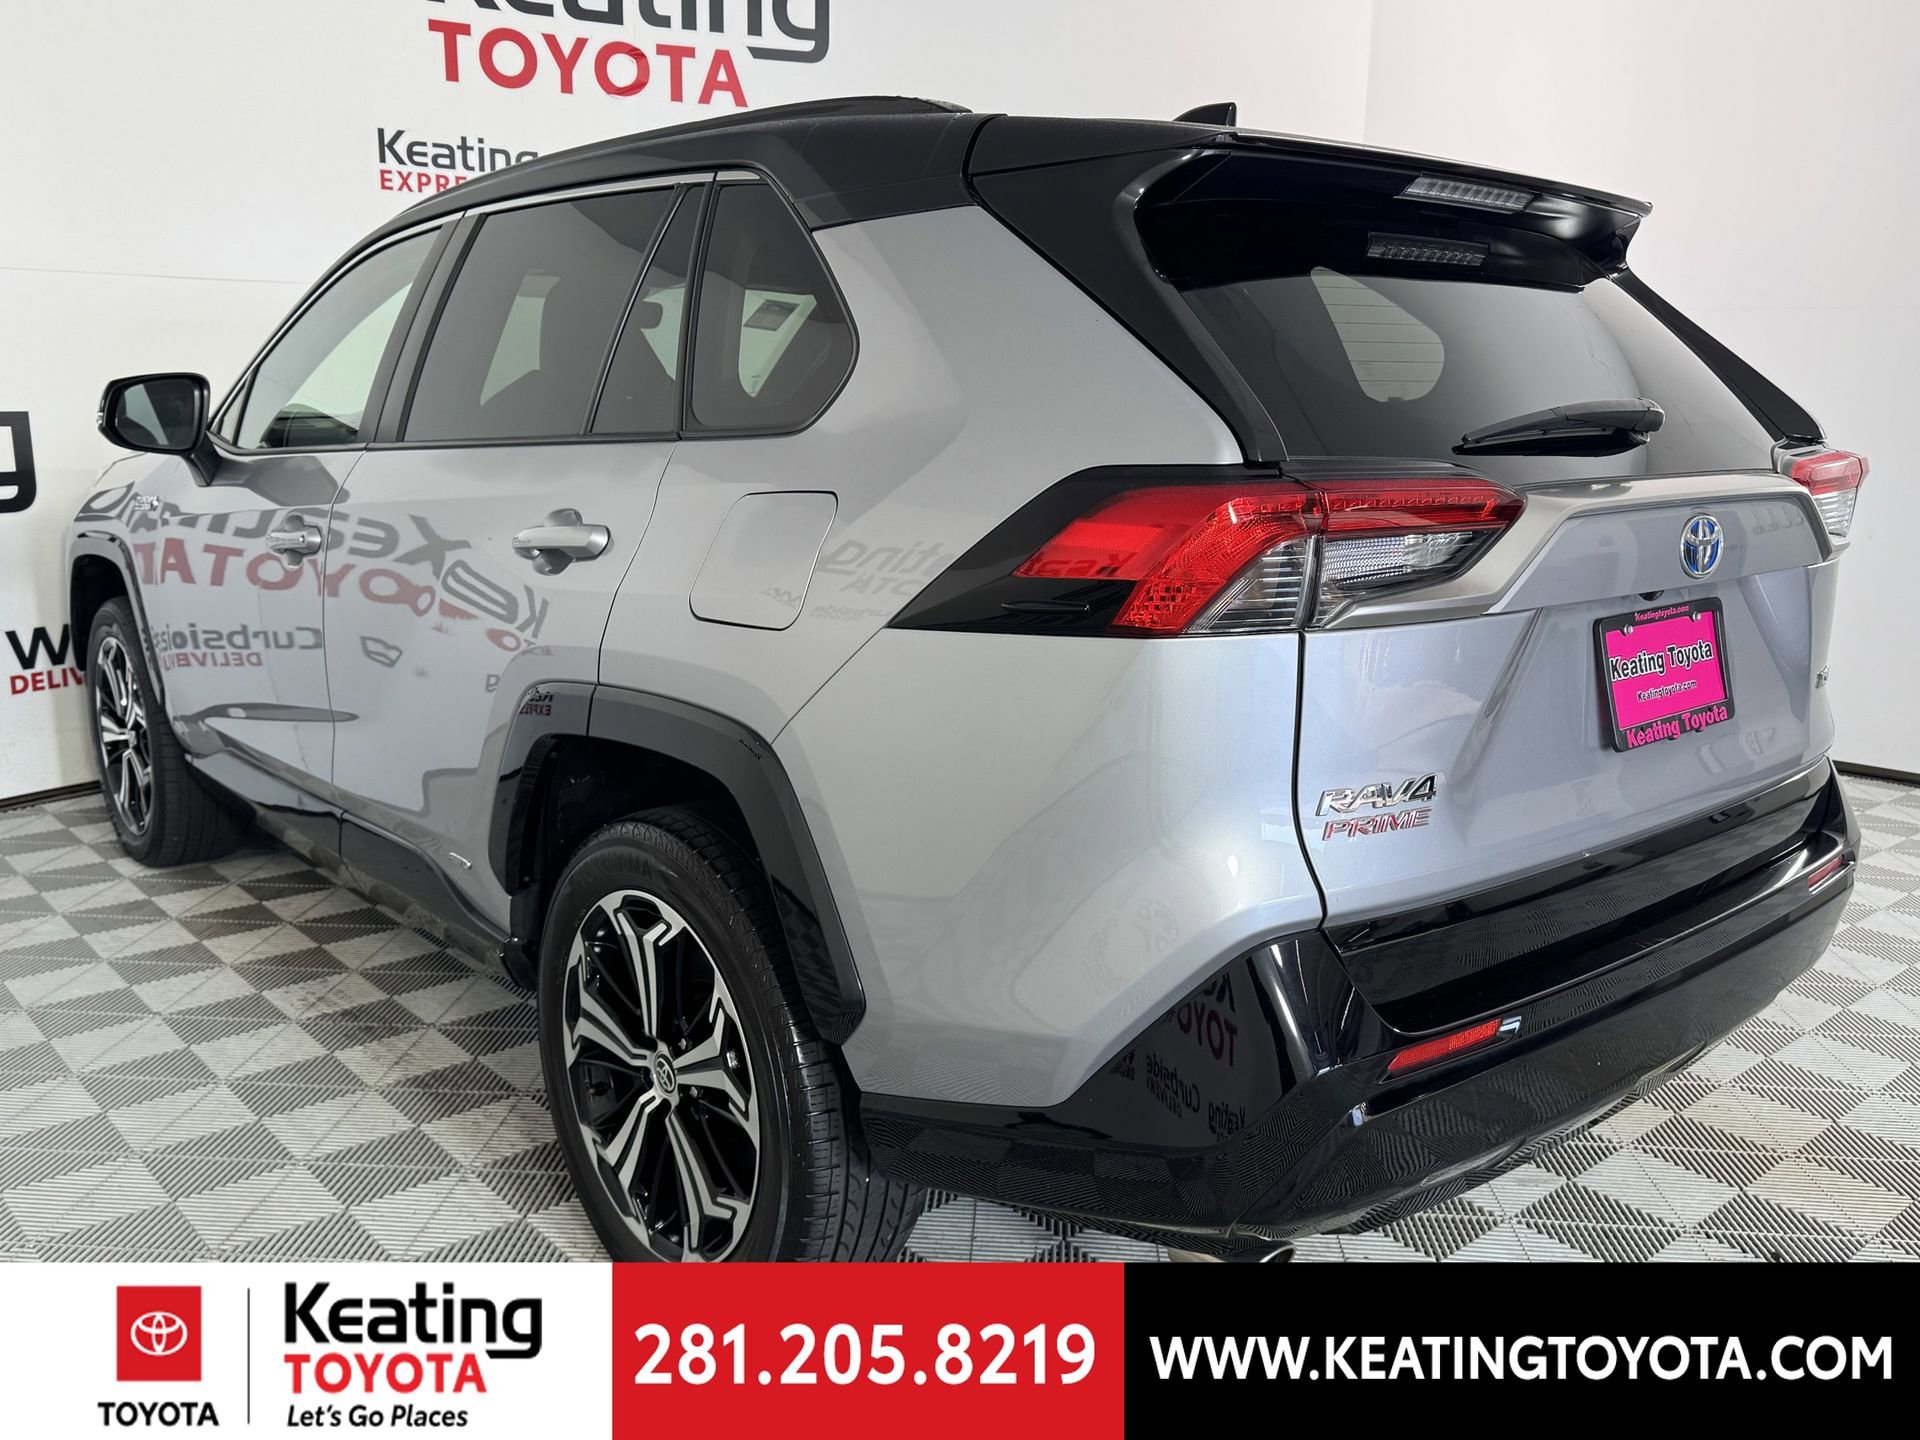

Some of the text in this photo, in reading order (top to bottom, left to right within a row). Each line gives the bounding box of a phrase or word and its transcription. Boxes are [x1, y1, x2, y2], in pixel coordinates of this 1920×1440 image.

[428, 19, 748, 107] TOYOTA
[1609, 640, 1713, 681] Keating Toyota
[1626, 704, 1728, 748] Keating Toyota
[1315, 772, 1437, 816] RAV4
[1322, 806, 1432, 840] PRIME
